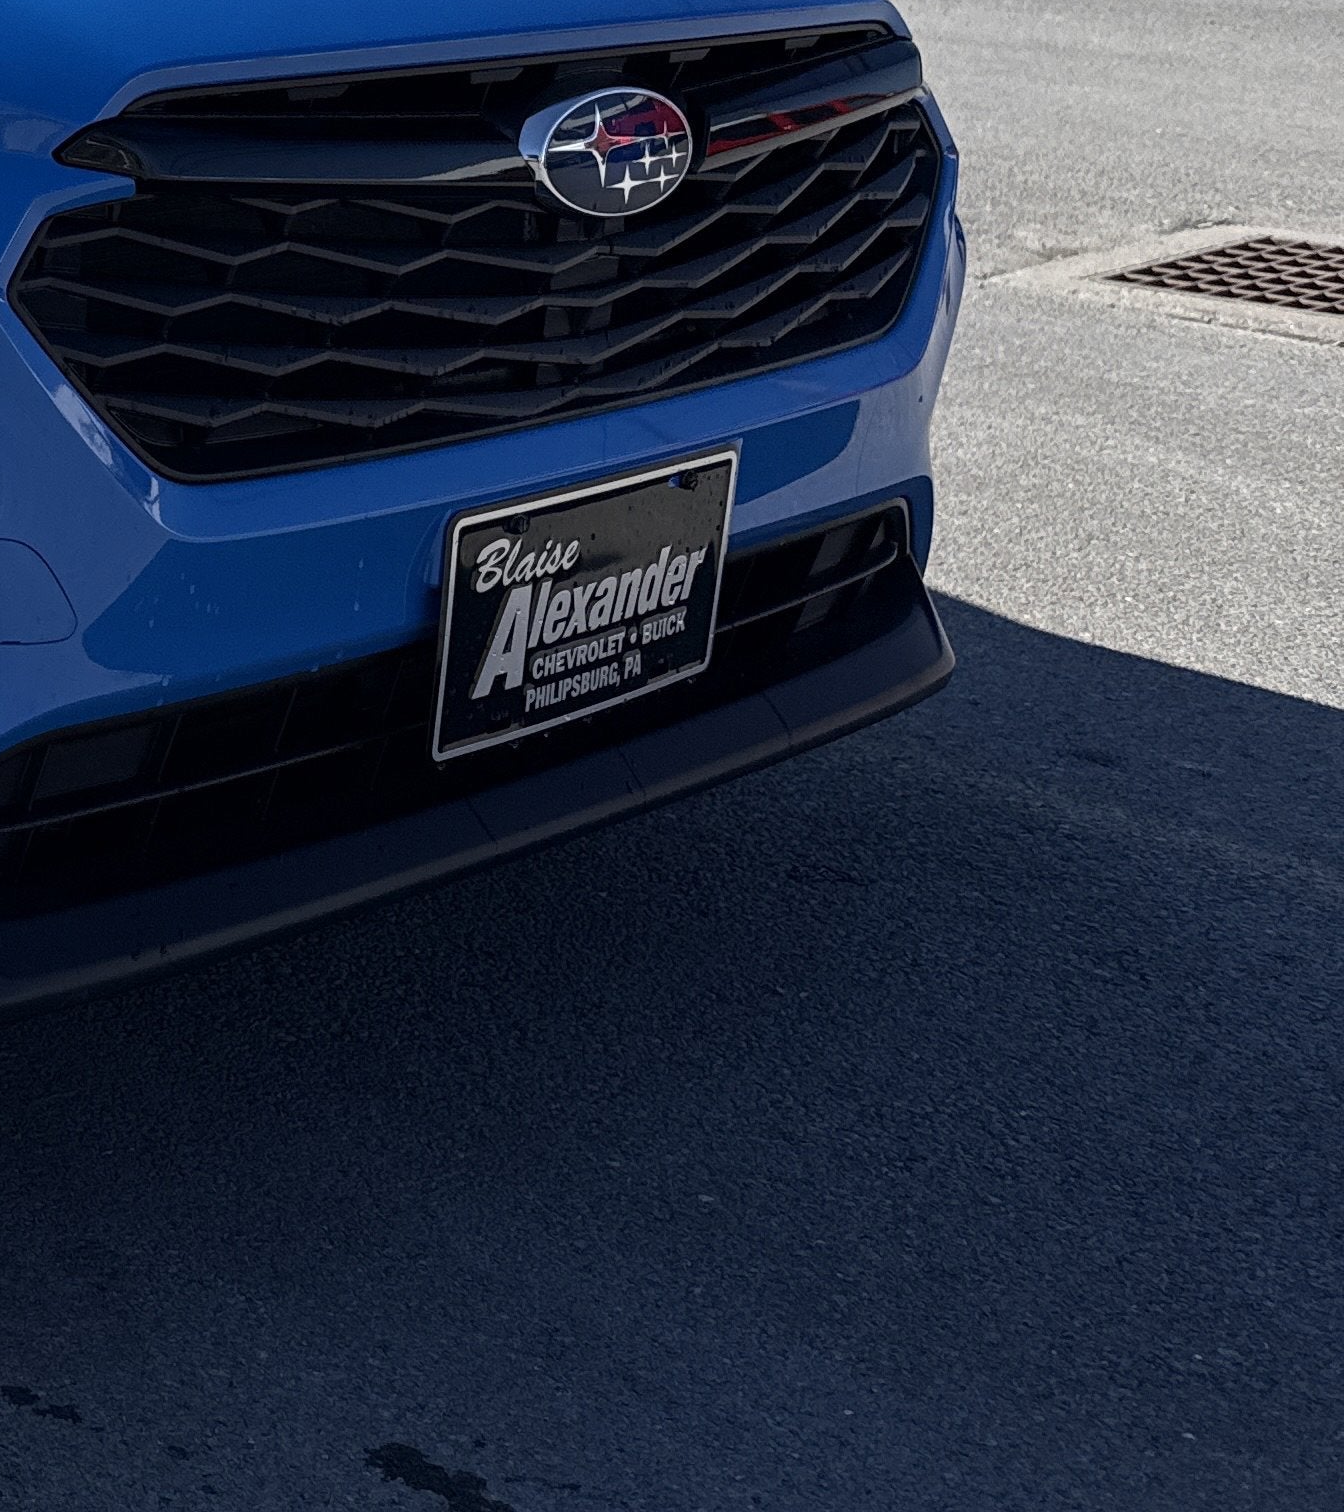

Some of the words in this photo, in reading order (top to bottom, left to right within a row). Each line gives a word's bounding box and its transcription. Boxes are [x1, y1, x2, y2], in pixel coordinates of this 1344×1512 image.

[475, 538, 580, 593] Blaise
[472, 545, 707, 699] Alexander
[532, 632, 626, 680] CHEVROLET
[642, 612, 686, 644] BUICK
[524, 665, 621, 713] PHILIPSBURG,
[625, 654, 642, 679] PA
